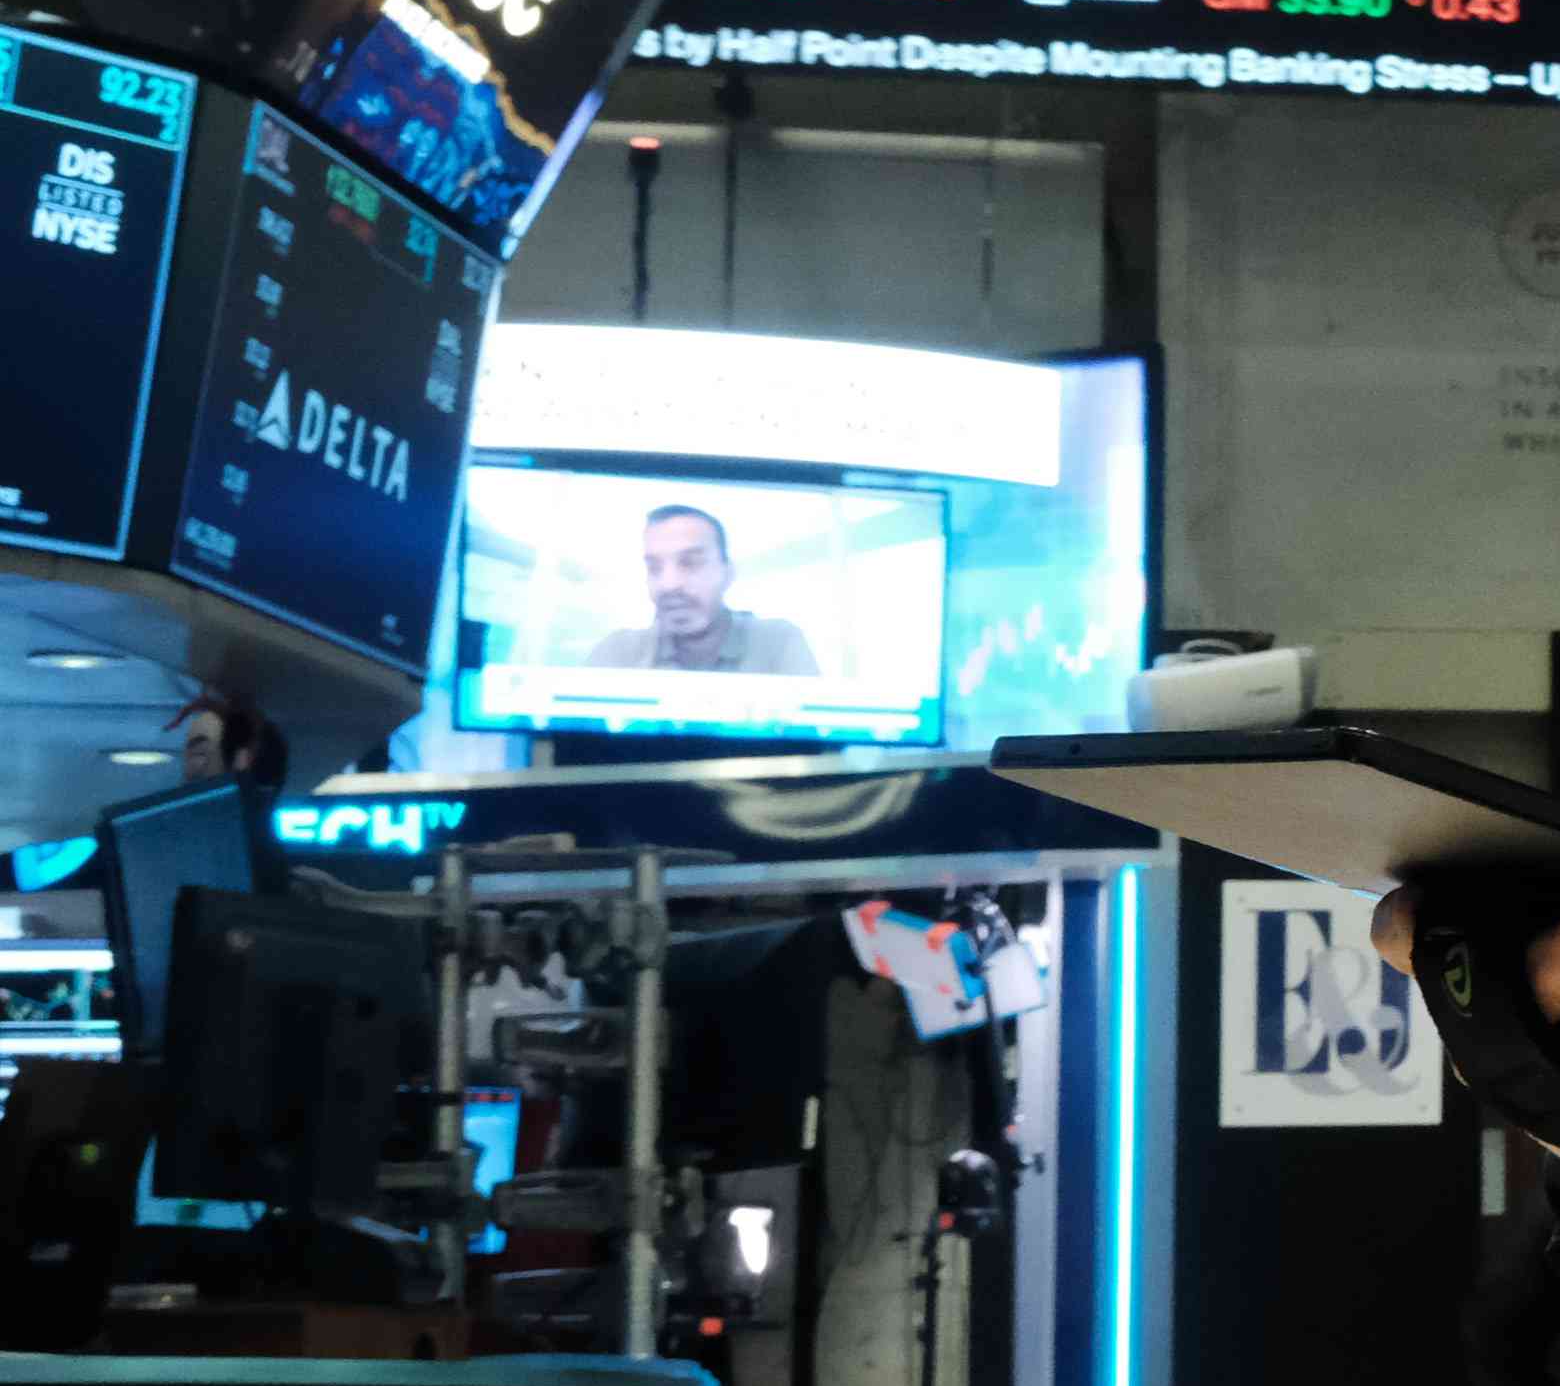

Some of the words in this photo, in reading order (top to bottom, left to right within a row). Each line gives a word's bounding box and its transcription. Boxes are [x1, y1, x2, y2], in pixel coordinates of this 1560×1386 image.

[664, 23, 716, 65] by
[719, 27, 796, 64] Half
[800, 29, 899, 70] Point
[901, 34, 1047, 78] Despite
[1048, 41, 1225, 88] Mounting
[1228, 47, 1373, 94] Banking
[57, 143, 115, 185] DIS
[32, 209, 120, 254] NYSE
[298, 389, 410, 502] DELTA
